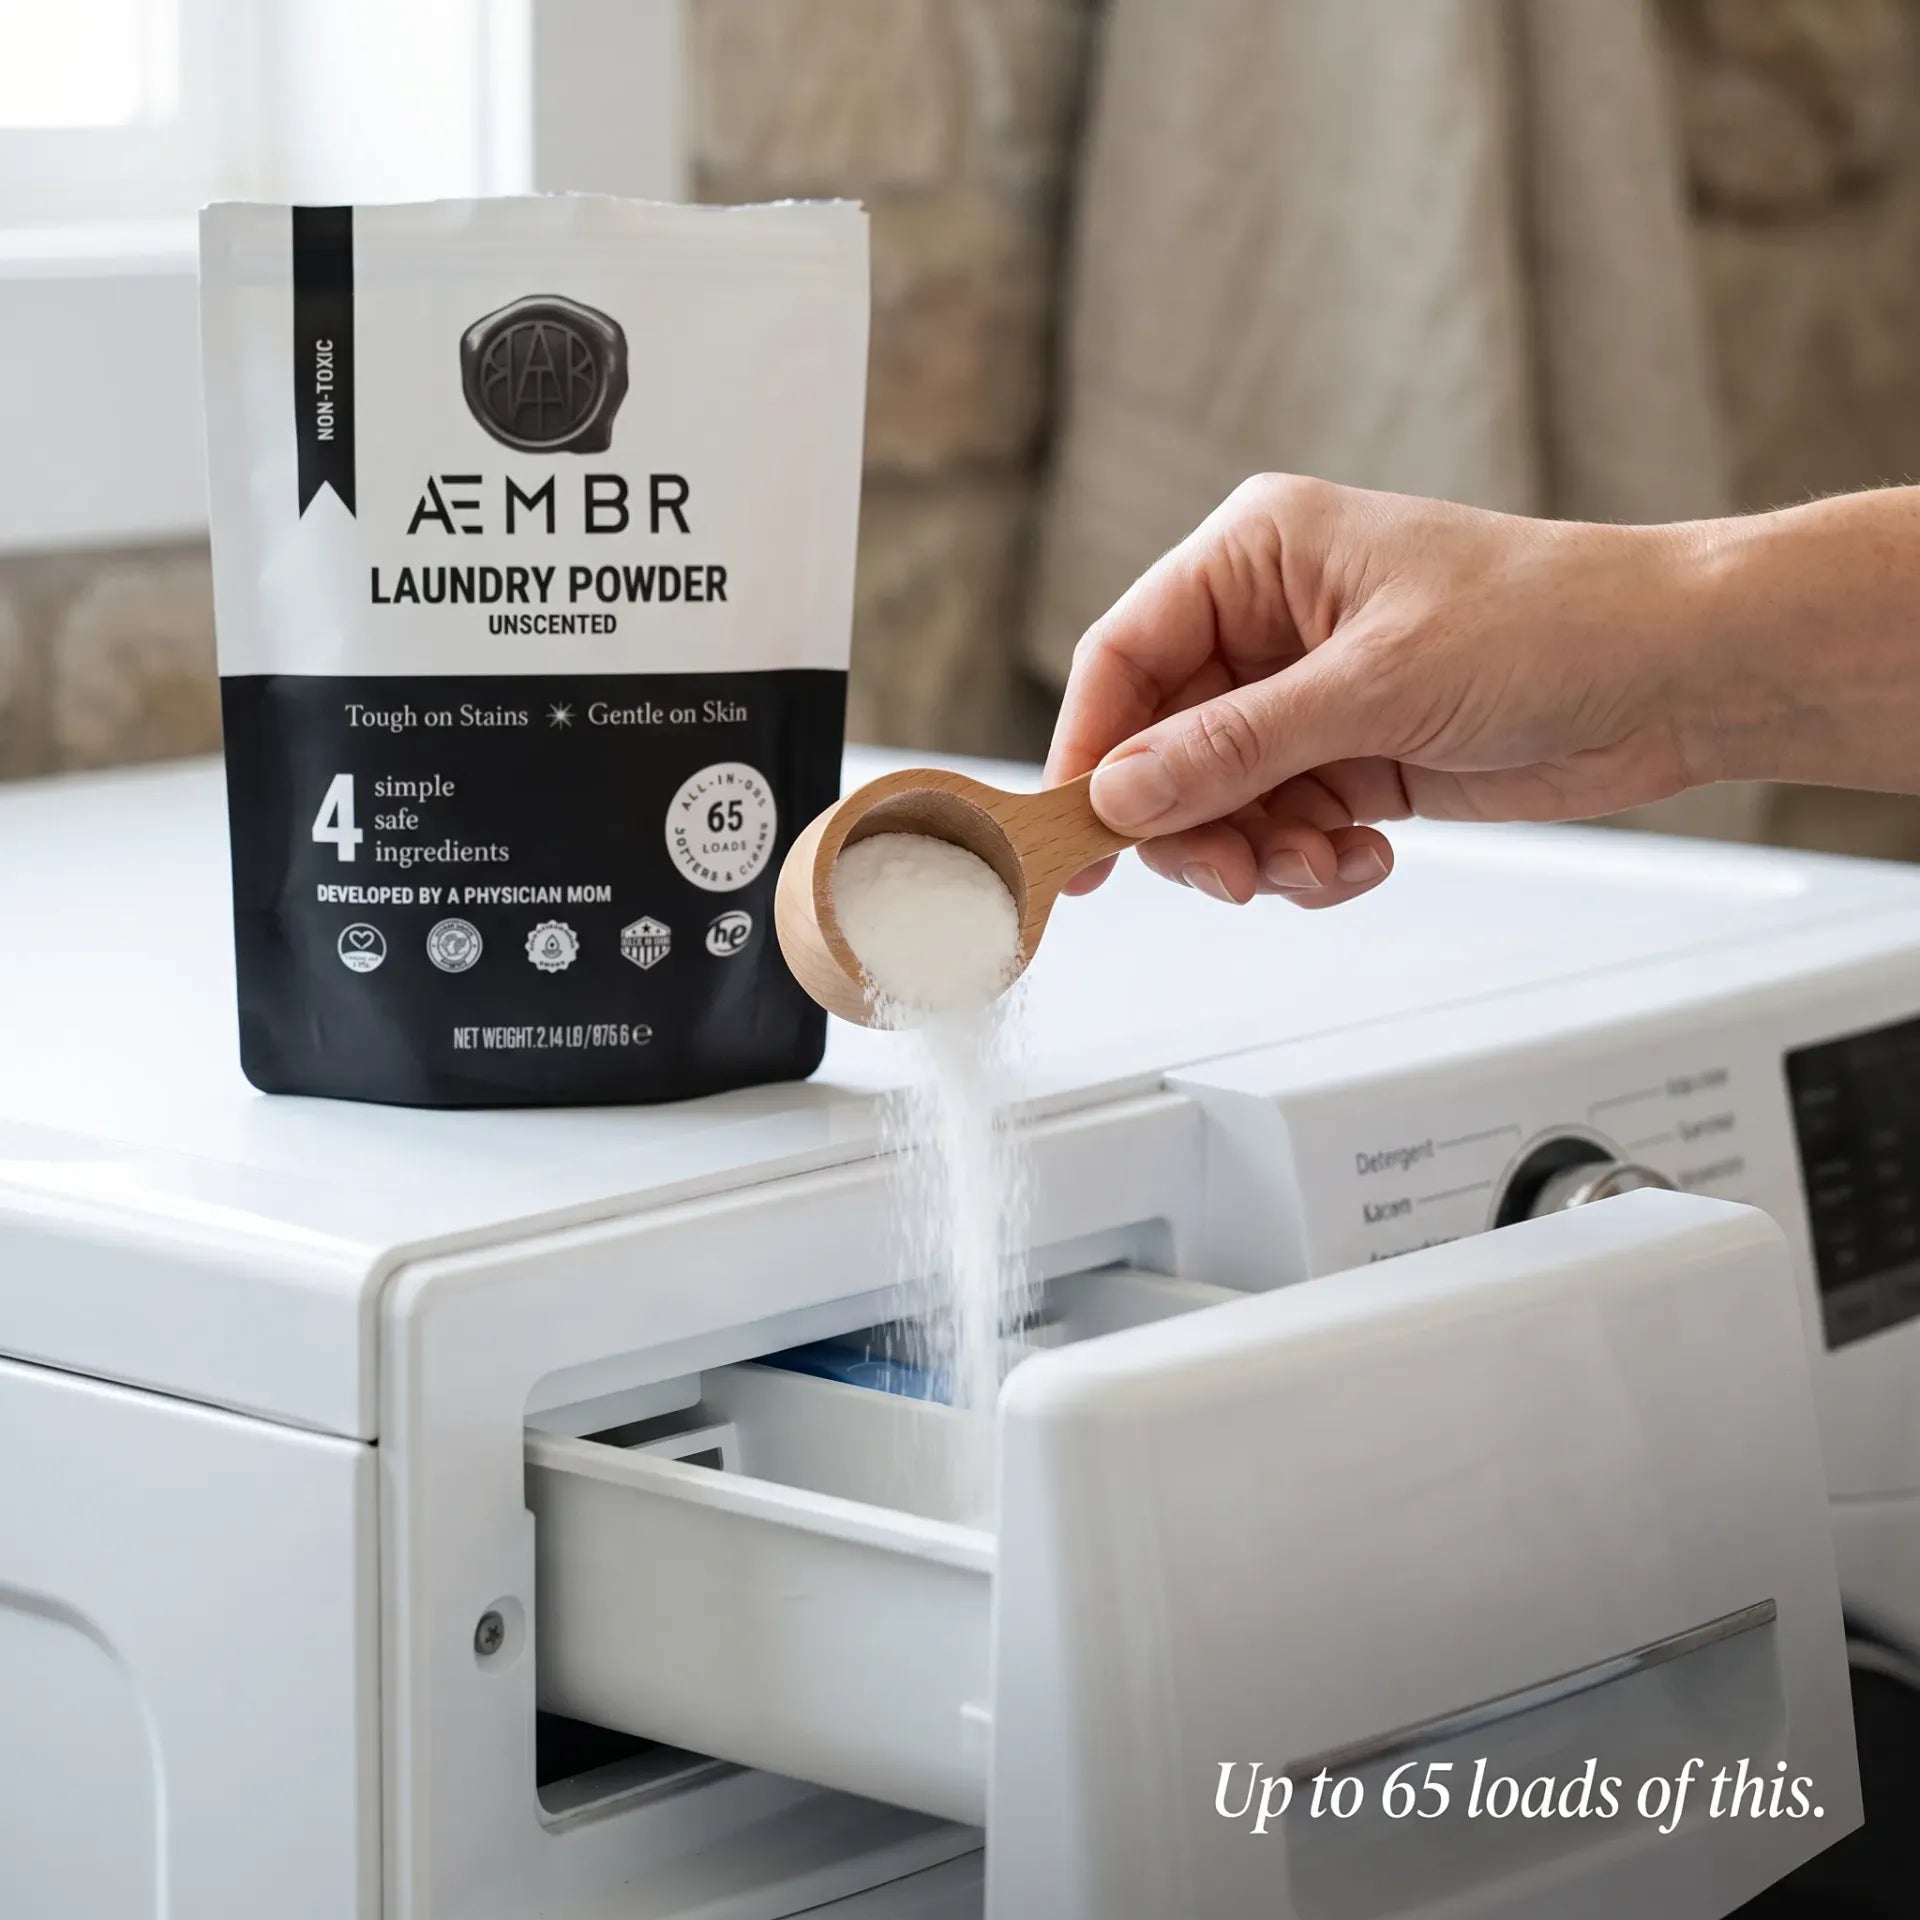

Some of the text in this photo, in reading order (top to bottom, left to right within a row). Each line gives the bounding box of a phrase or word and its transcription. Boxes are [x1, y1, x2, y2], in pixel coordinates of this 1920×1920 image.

[315, 339, 335, 441] NON-TOXIC
[371, 565, 728, 604] LAUNDRY POWDER
[488, 613, 617, 636] UNSCENTED
[344, 700, 747, 734] Tough on Stains Gentle on Skin
[374, 773, 455, 803] simple
[311, 773, 364, 862] 4
[374, 806, 419, 831] safe
[707, 799, 744, 833] 65
[375, 838, 510, 869] ingredients
[316, 883, 611, 905] DEVELOPED BY A PHYSICIAN MOM
[713, 920, 748, 948] he
[453, 1026, 480, 1050] NET
